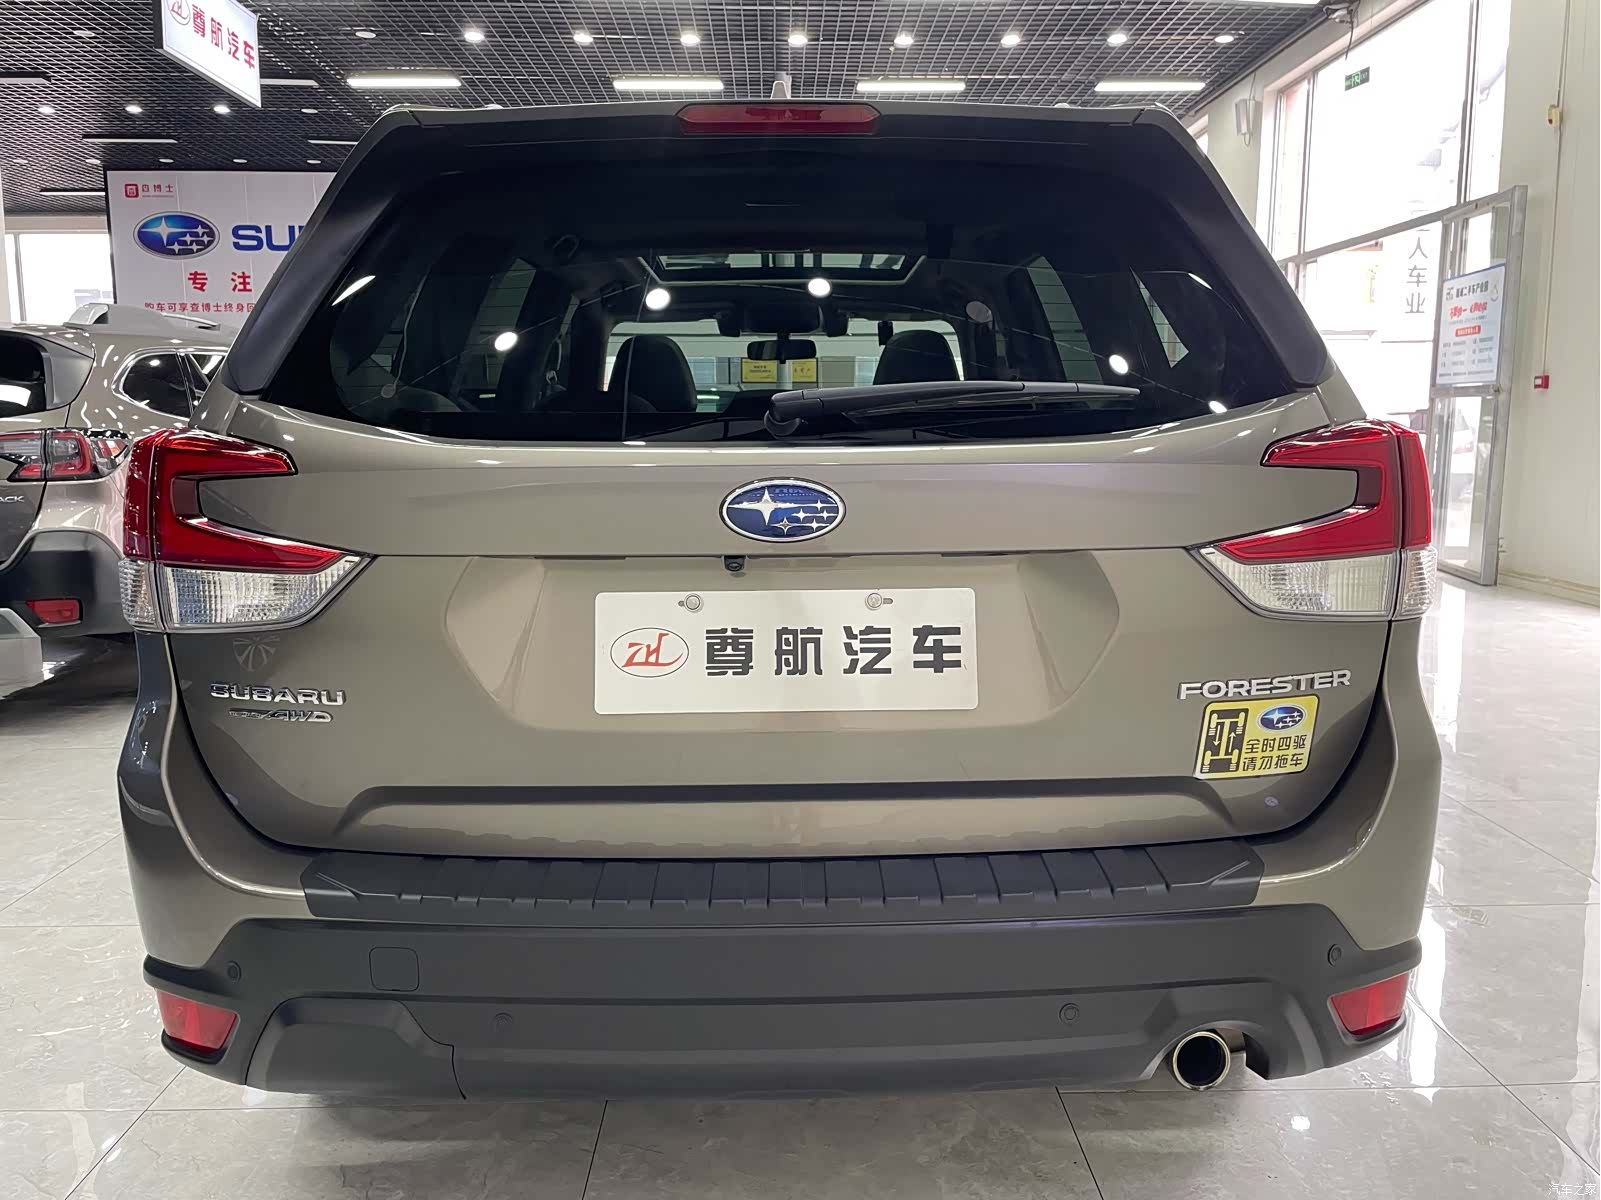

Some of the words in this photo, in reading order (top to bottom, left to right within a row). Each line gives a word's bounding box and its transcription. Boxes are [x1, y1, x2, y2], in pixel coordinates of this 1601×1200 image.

[231, 224, 304, 251] SU
[705, 624, 962, 677] 尊航汽车
[210, 682, 346, 706] SUBARU
[1179, 669, 1351, 700] FORESTER
[1245, 734, 1307, 755] 全时四驱
[1242, 752, 1304, 772] 请勿拖车
